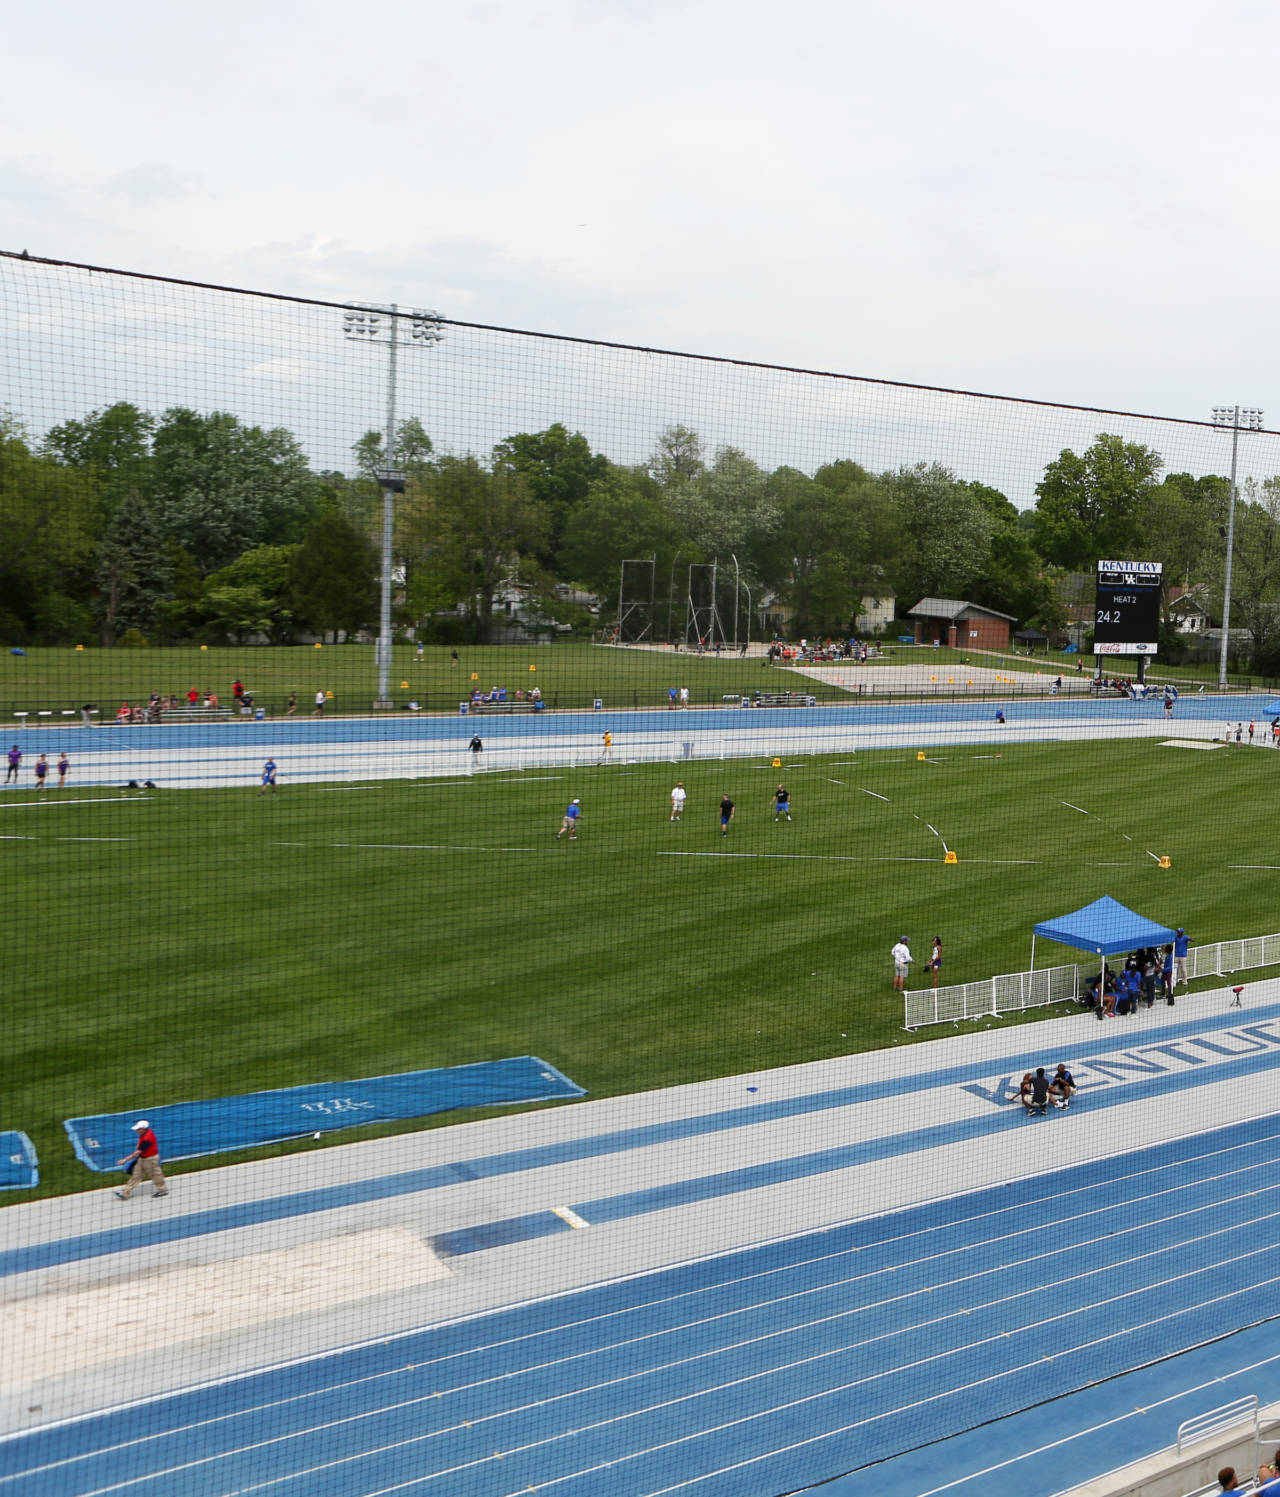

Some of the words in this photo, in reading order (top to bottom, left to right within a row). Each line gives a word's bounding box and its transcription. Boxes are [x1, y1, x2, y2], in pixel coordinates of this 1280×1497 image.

[1102, 561, 1157, 572] KENTUCKY
[1113, 595, 1131, 604] HEAT
[1132, 596, 1137, 604] 2
[1097, 610, 1120, 623] 24.2
